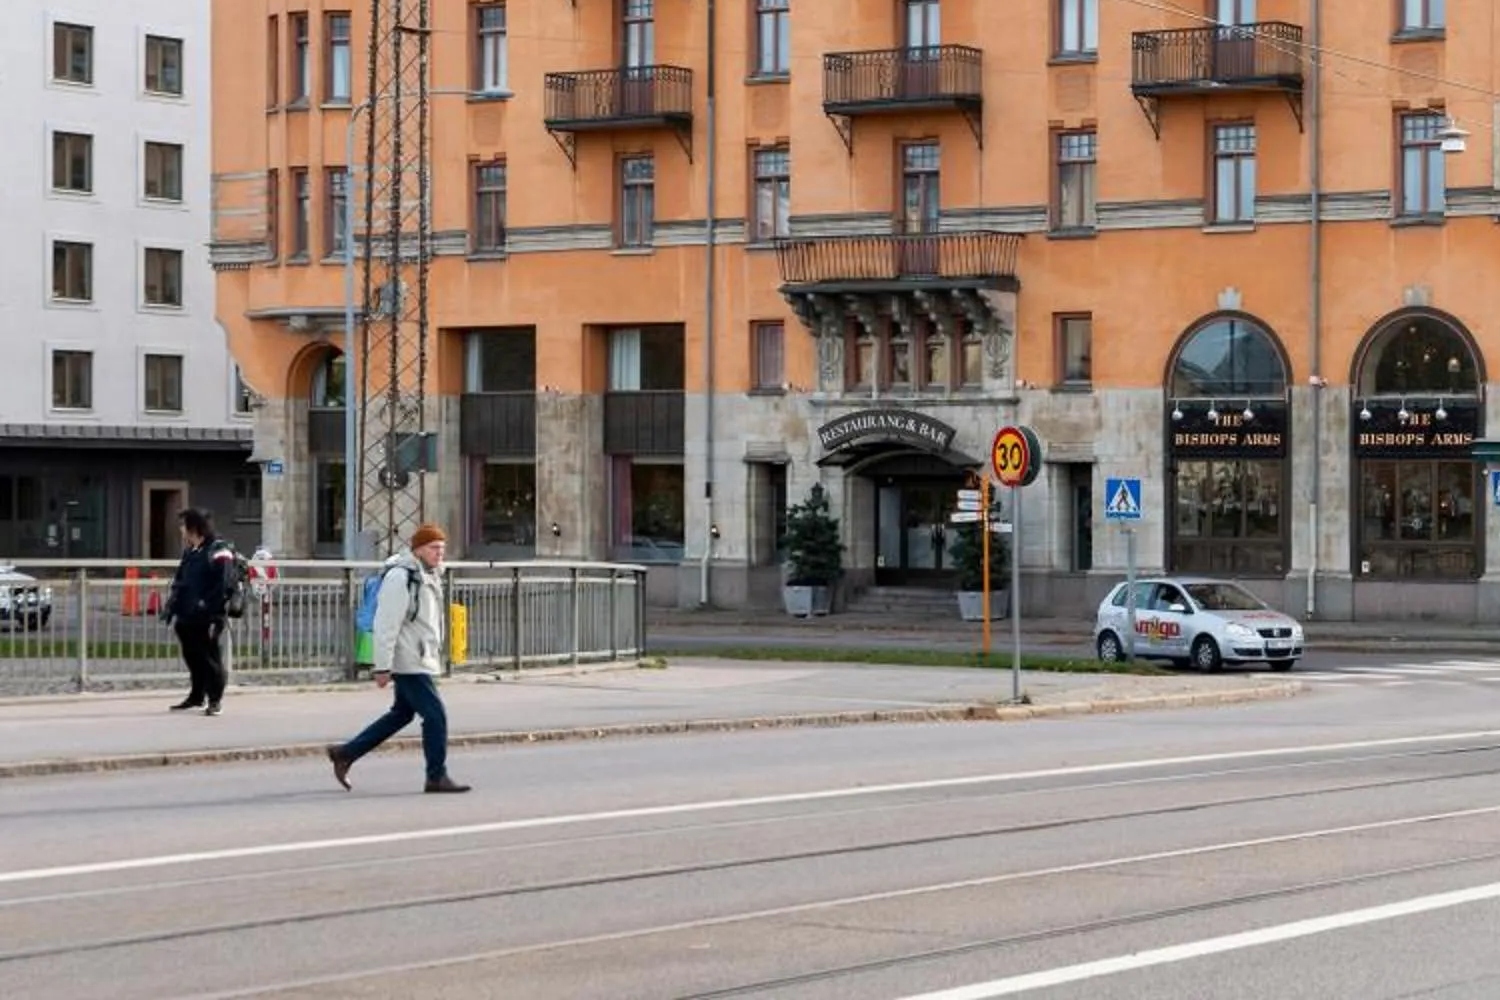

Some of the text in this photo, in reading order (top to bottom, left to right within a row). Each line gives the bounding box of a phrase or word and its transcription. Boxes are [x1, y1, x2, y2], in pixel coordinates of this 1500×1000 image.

[821, 415, 946, 445] RESTAURANG & BAR
[1175, 433, 1281, 446] BISHOPS ARMS
[1359, 433, 1473, 446] BISHOPS ARMS
[997, 443, 1023, 471] 30
